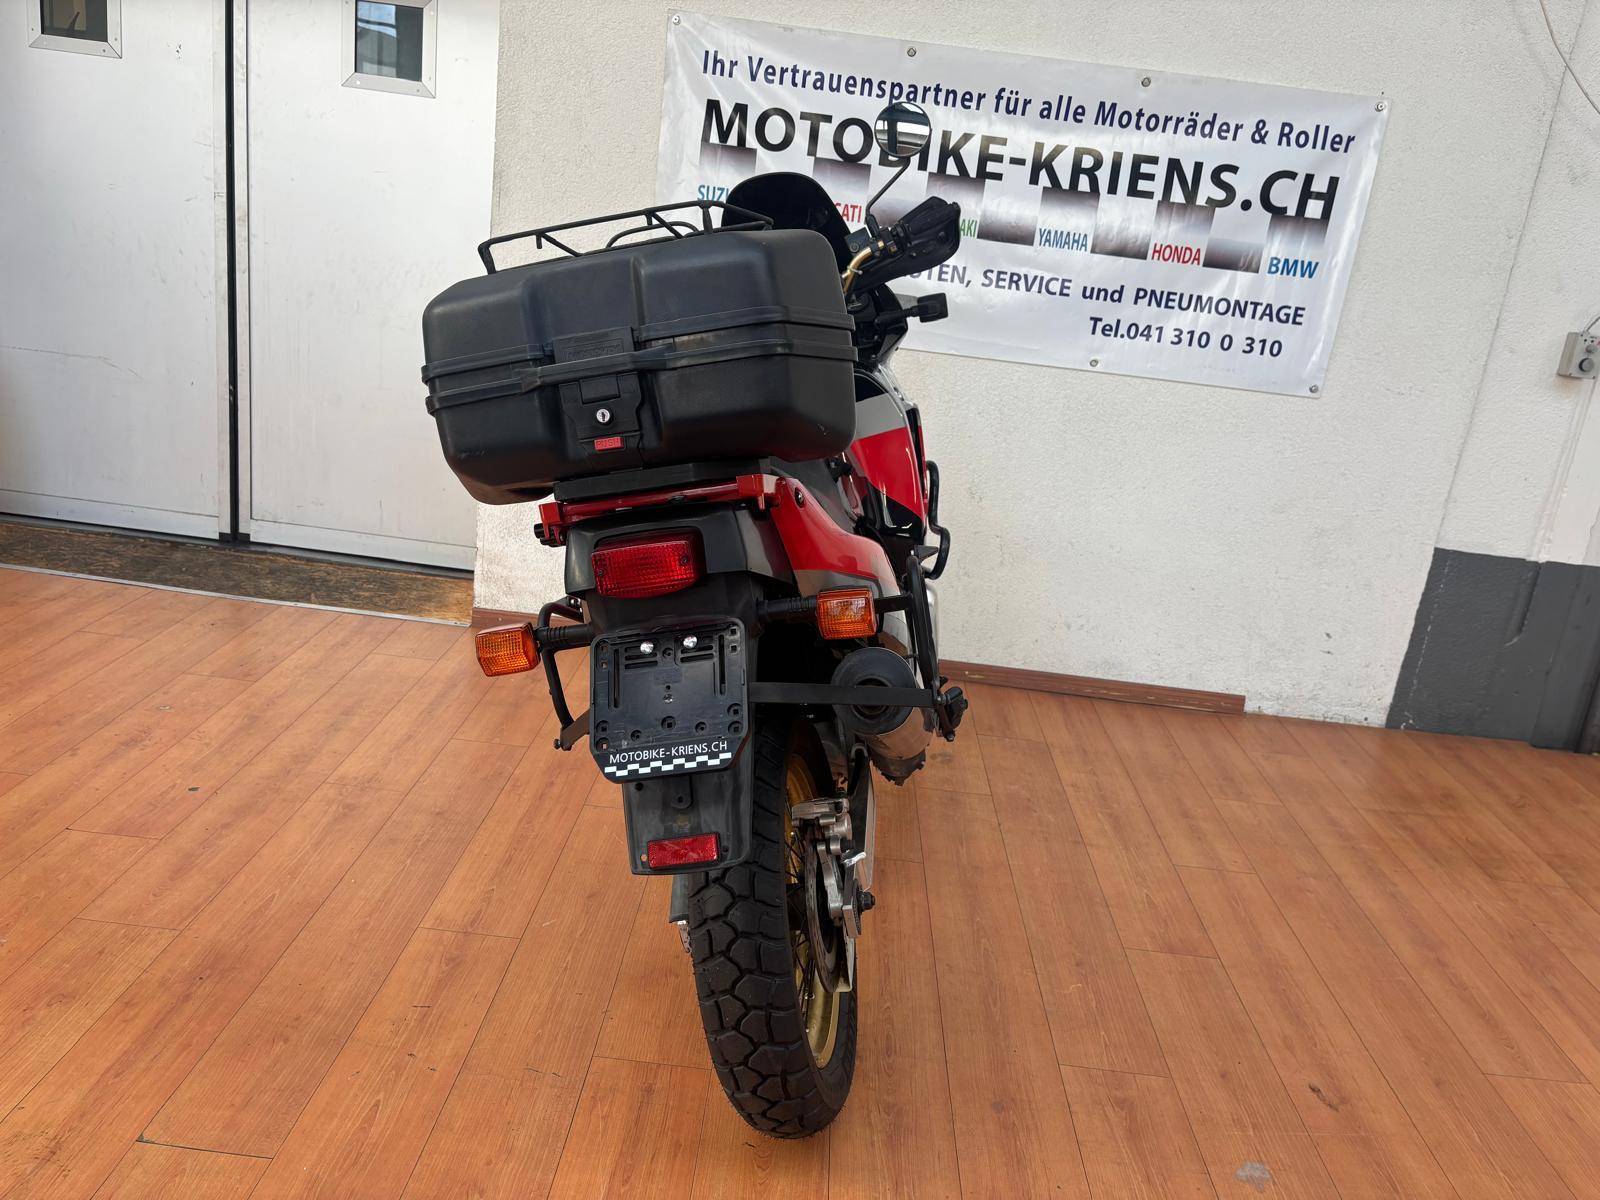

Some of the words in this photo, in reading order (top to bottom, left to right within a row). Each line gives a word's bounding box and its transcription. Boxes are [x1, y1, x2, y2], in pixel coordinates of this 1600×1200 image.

[702, 50, 738, 79] Ihr
[747, 55, 986, 111] Vertrauenspartner
[994, 87, 1032, 117] für
[1039, 95, 1086, 123] alle
[1094, 101, 1244, 142] Motorräder
[1251, 119, 1269, 145] &
[1277, 121, 1356, 154] Roller
[701, 98, 1340, 220] MOTOIKE-KRIENS.CH
[1038, 228, 1088, 252] YAMAHA
[1151, 243, 1201, 266] HONDA
[1267, 257, 1319, 279] BMW
[981, 269, 1073, 297] SERVICE
[1081, 284, 1125, 304] und
[1133, 287, 1306, 326] PNEUMONTAGE
[1171, 328, 1210, 350] 310
[1219, 333, 1233, 352] 0
[1242, 336, 1283, 358] 310
[609, 740, 728, 764] MOTOBIKE-KRIENS.CH
